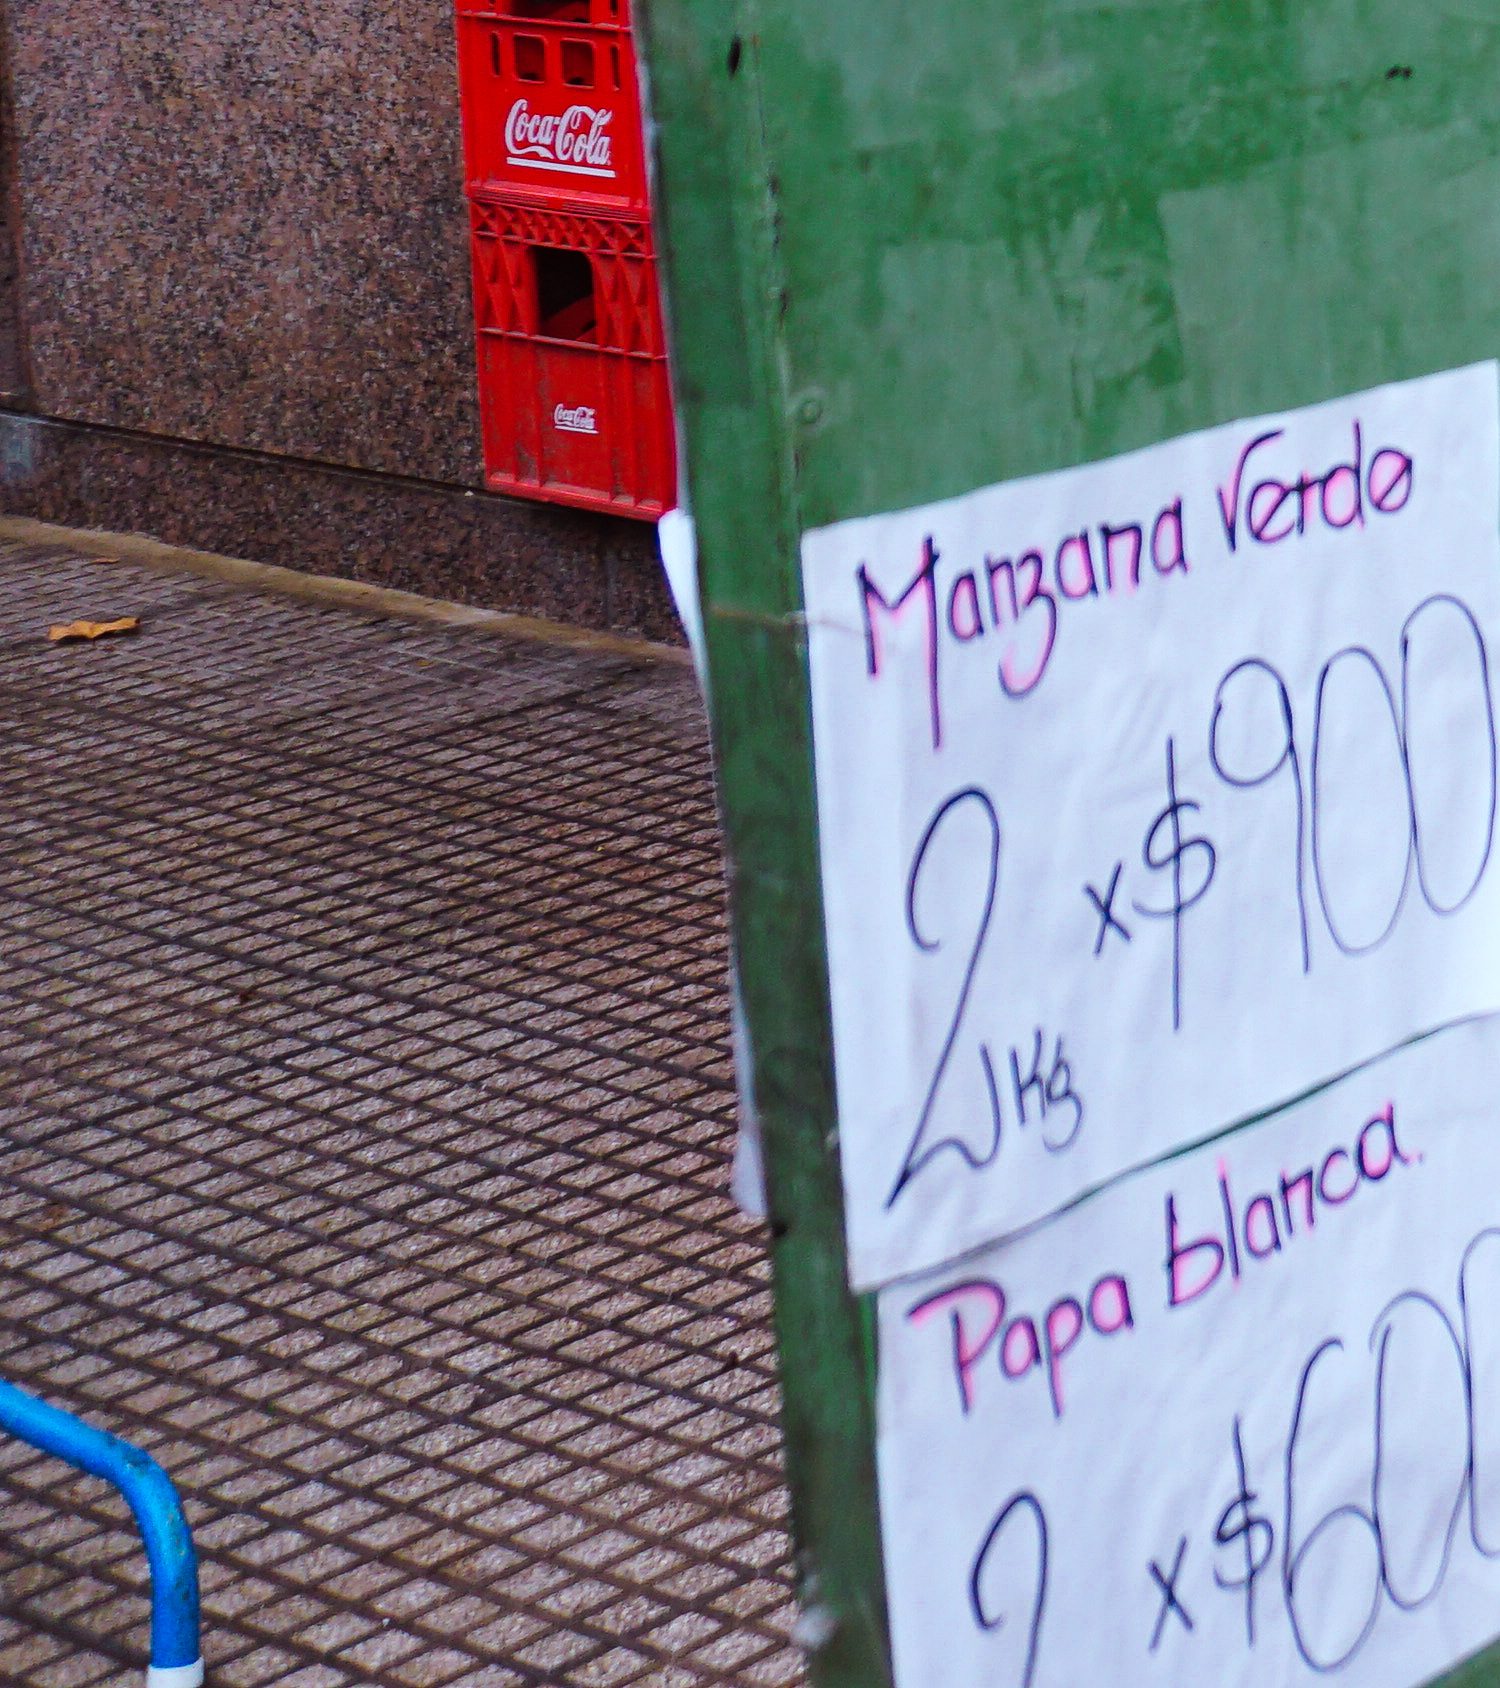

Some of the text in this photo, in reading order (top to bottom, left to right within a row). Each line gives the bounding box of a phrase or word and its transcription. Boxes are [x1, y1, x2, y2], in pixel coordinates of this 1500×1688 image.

[504, 98, 613, 166] Coca-Cola
[553, 403, 596, 430] Coca-Cola
[855, 496, 1189, 750] Manzana
[903, 1270, 1135, 1419] Papa
